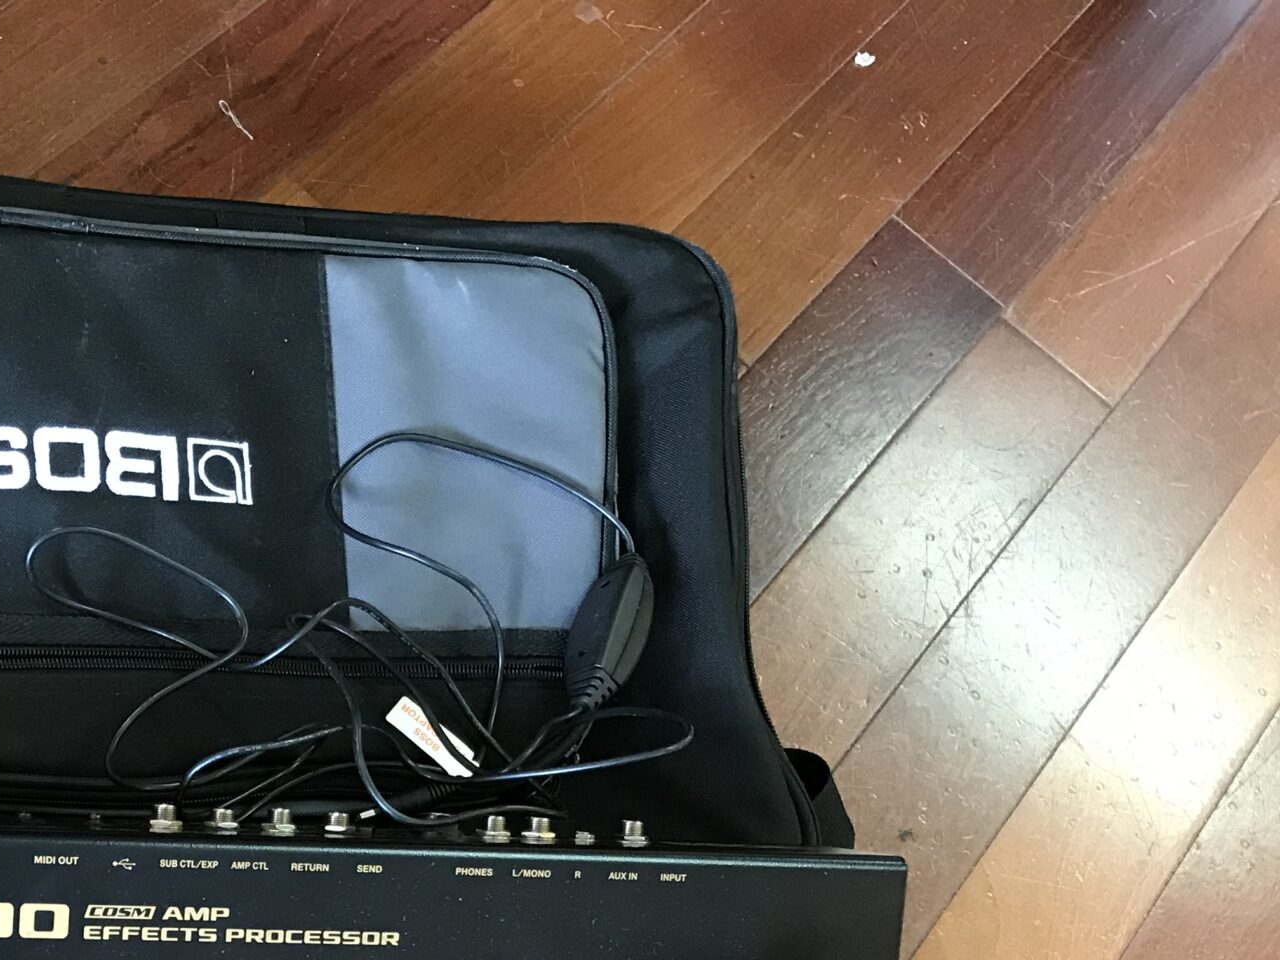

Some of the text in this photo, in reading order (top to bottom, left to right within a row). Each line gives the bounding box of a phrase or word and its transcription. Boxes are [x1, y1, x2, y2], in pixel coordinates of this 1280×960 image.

[33, 855, 80, 865] MIDI OUT
[159, 858, 219, 869] SUB CTL/EXP
[230, 861, 269, 871] AMP CTL
[290, 862, 330, 872] RETURN
[356, 864, 383, 874] SEND
[455, 867, 494, 877] PHONES
[512, 868, 552, 878] L/MONO
[574, 870, 582, 879] R
[608, 871, 638, 881] AUX IN
[660, 873, 687, 882] INPUT
[83, 904, 230, 922] COSM AMP
[83, 925, 400, 946] EFFECTS PROCESSOR
